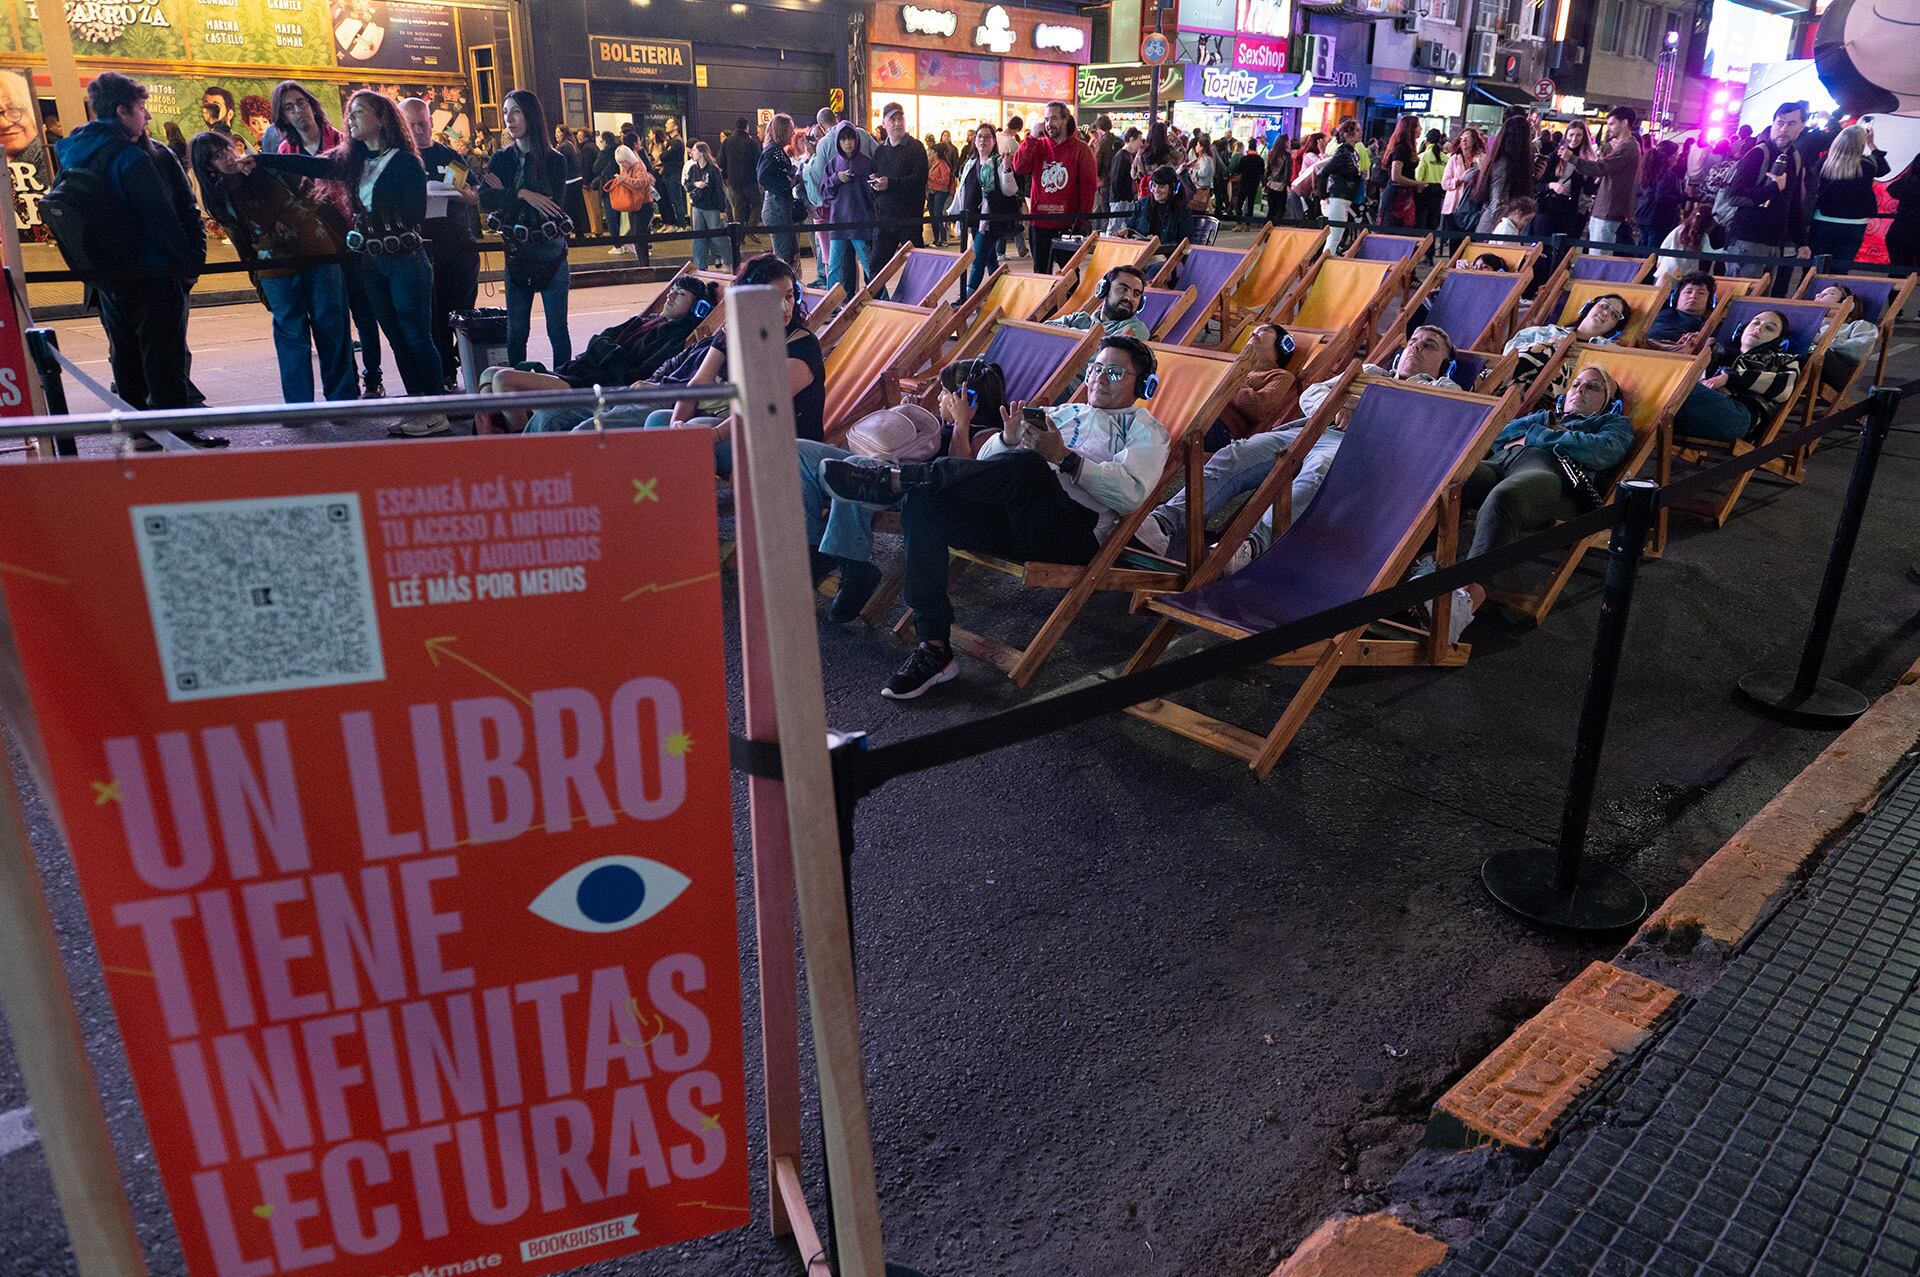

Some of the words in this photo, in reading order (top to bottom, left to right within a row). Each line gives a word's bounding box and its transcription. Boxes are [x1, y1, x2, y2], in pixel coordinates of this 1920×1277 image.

[205, 33, 245, 46] CASTILLO
[206, 20, 240, 32] MARINA
[599, 42, 683, 66] BOLETERIA
[1238, 43, 1285, 72] SexShop
[148, 95, 176, 105] JACOBO
[376, 477, 465, 516] ESCANEÁ
[471, 475, 509, 510] ACÁ
[512, 480, 525, 507] Y
[530, 472, 573, 505] PEDÍ
[380, 519, 408, 548] TU
[413, 513, 489, 545] ACCESO
[494, 512, 507, 539] A
[511, 506, 601, 538] INFINITOS
[384, 547, 455, 578] LIBROS
[460, 546, 473, 572] Y
[479, 536, 602, 570] AUDIOLIBROS
[388, 573, 423, 609] LEÉ
[426, 568, 473, 605] MÁS
[475, 572, 516, 600] POR
[519, 566, 588, 598] MENOS
[103, 719, 310, 891] UN
[340, 676, 688, 862] LIBRO
[113, 855, 475, 1041] TIENE
[169, 952, 713, 1167] INFINITAS
[191, 1070, 728, 1277] LECTURAS
[527, 1221, 626, 1258] BOOKBUSTER
